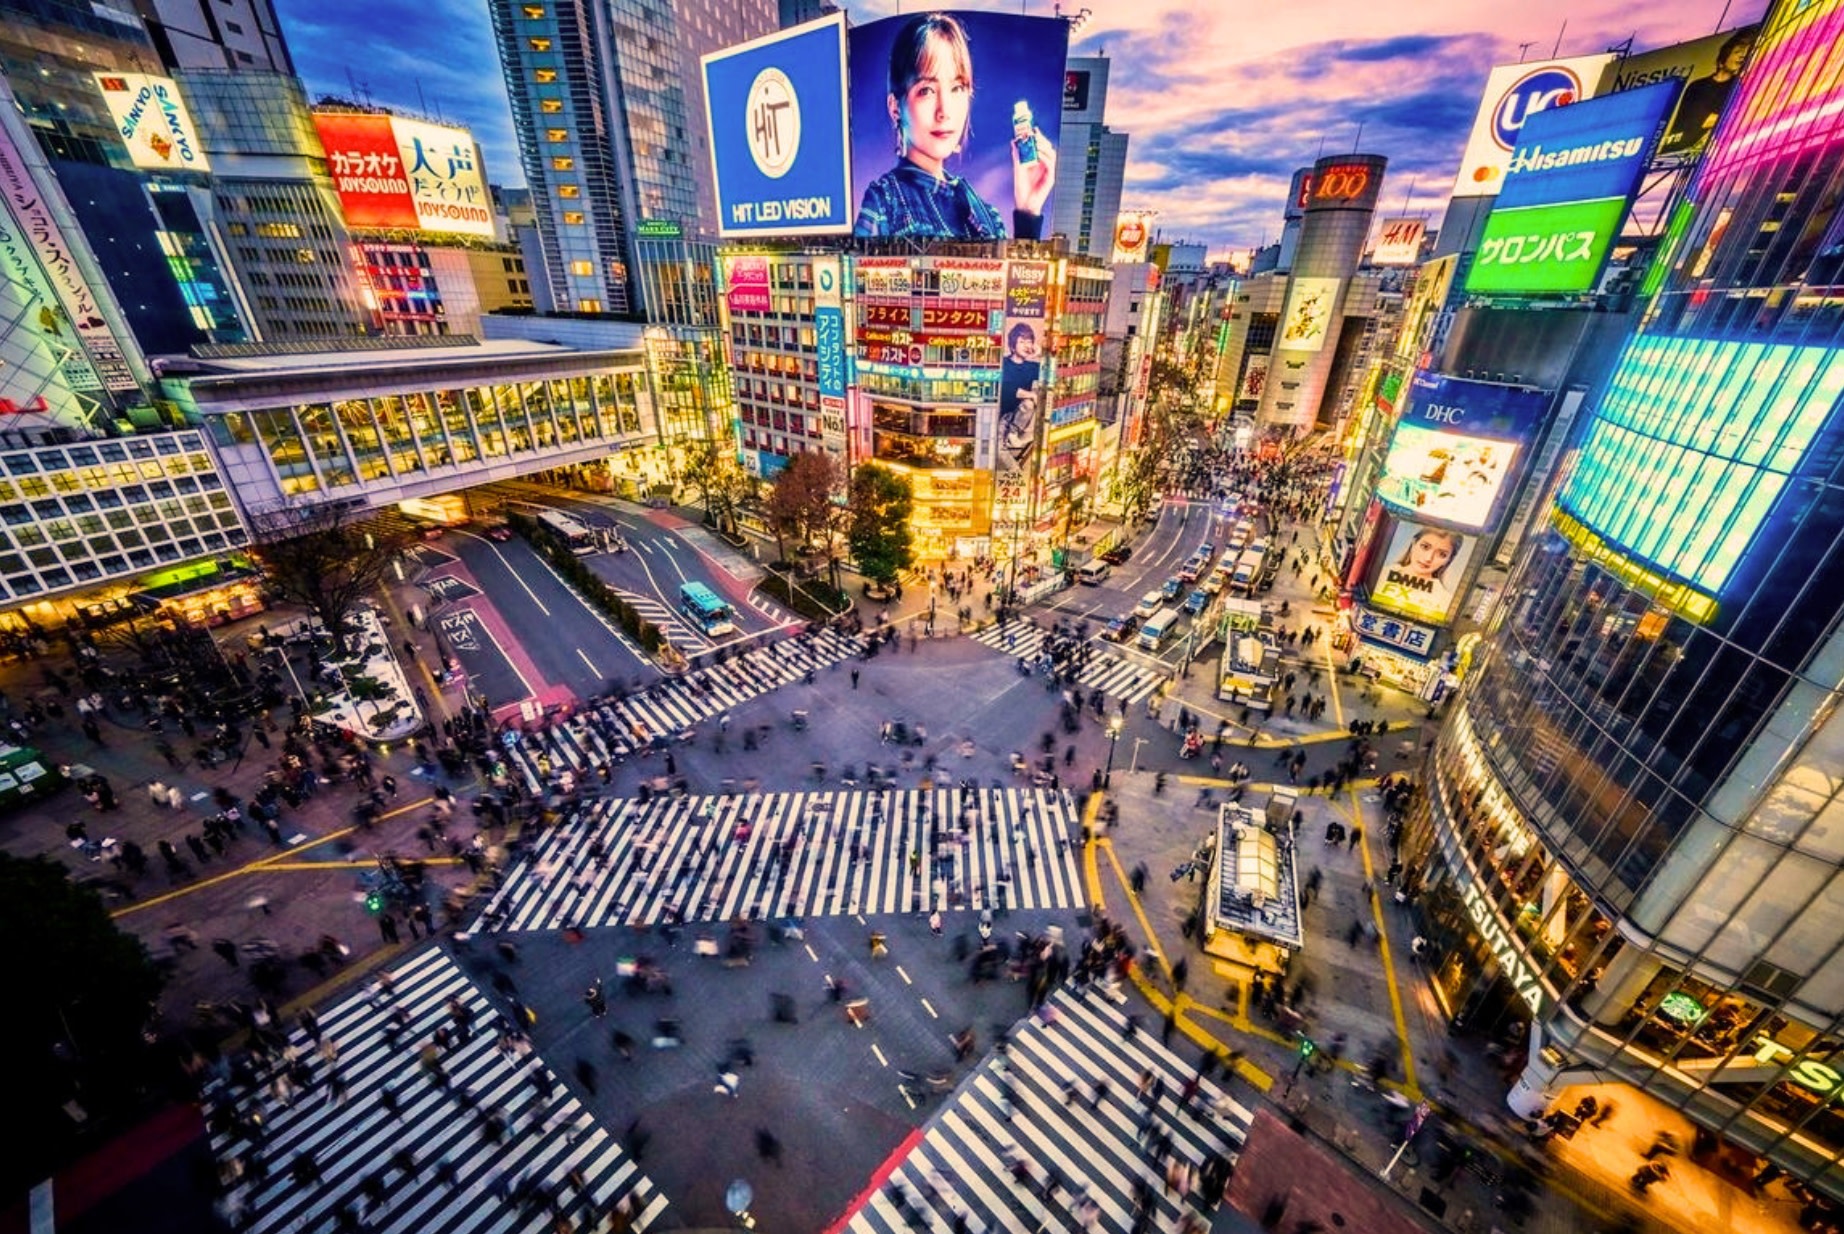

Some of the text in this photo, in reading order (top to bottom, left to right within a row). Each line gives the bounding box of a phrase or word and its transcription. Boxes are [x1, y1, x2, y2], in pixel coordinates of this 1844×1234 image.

[121, 86, 152, 139] SANKYO
[153, 84, 195, 162] SANKYO
[330, 151, 399, 177] カラオケ
[1508, 136, 1644, 173] Hisamitsu
[339, 176, 408, 194] JOYSOUND
[418, 201, 489, 223] JOYSOUND
[732, 196, 831, 223] HIT LED VISION
[1382, 224, 1420, 245] H&M
[1480, 231, 1596, 265] サロンパス
[1012, 265, 1045, 282] Nissy
[924, 310, 986, 325] コンタクト
[891, 331, 913, 346] ガスト
[966, 336, 995, 349] ガスト
[818, 315, 832, 389] アイシティ
[830, 315, 840, 390] コンタクトの
[881, 346, 907, 363] ガスト
[823, 414, 845, 433] No.1
[1425, 404, 1465, 425] DHC
[1382, 583, 1411, 601] FX
[1387, 570, 1435, 593] DMM
[1361, 613, 1428, 648] 堂書店
[1464, 881, 1545, 1014] TSUTAYA
[1755, 1036, 1844, 1104] TS
